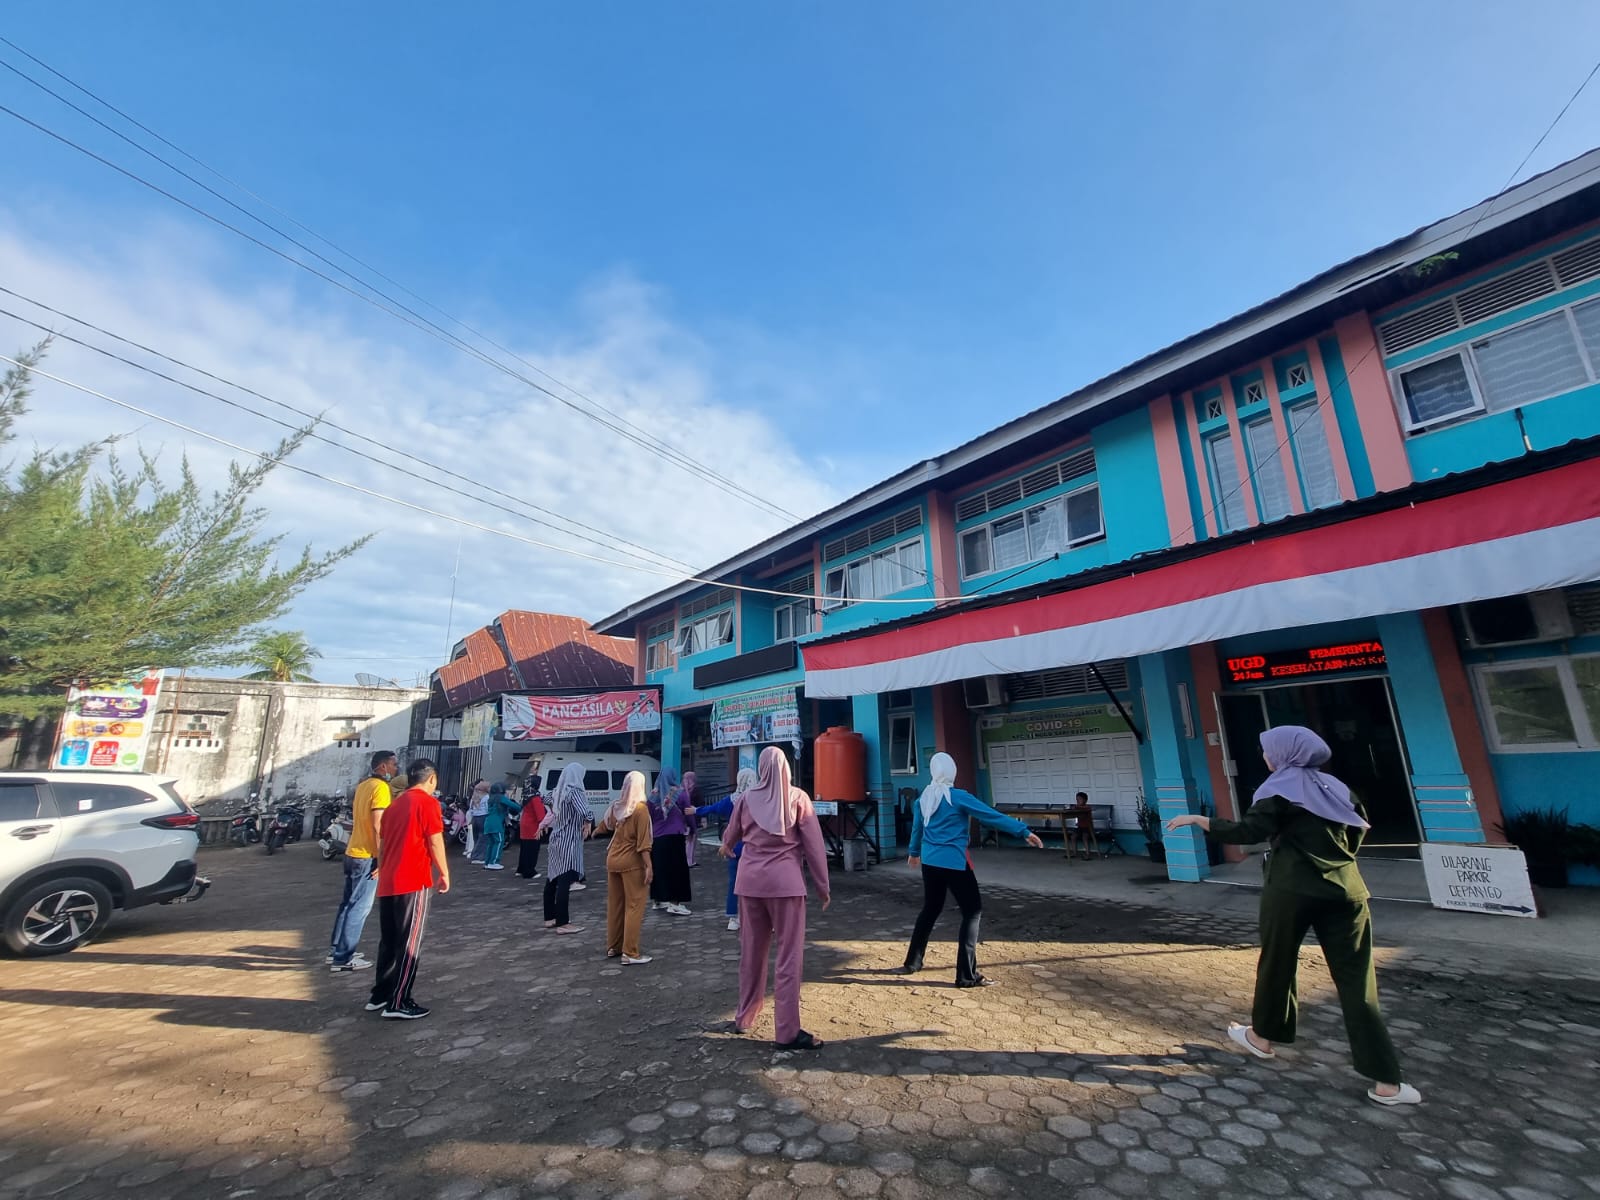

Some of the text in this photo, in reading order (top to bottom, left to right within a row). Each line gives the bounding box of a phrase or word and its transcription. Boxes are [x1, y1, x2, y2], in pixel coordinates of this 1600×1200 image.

[1227, 656, 1266, 671] UGD
[1233, 672, 1246, 680] 24
[541, 701, 614, 718] PANCASILA
[1026, 718, 1082, 732] COVID-19
[1441, 855, 1492, 872] DILARANG
[1456, 870, 1491, 883] PARKIR
[1448, 884, 1484, 898] DEPAN
